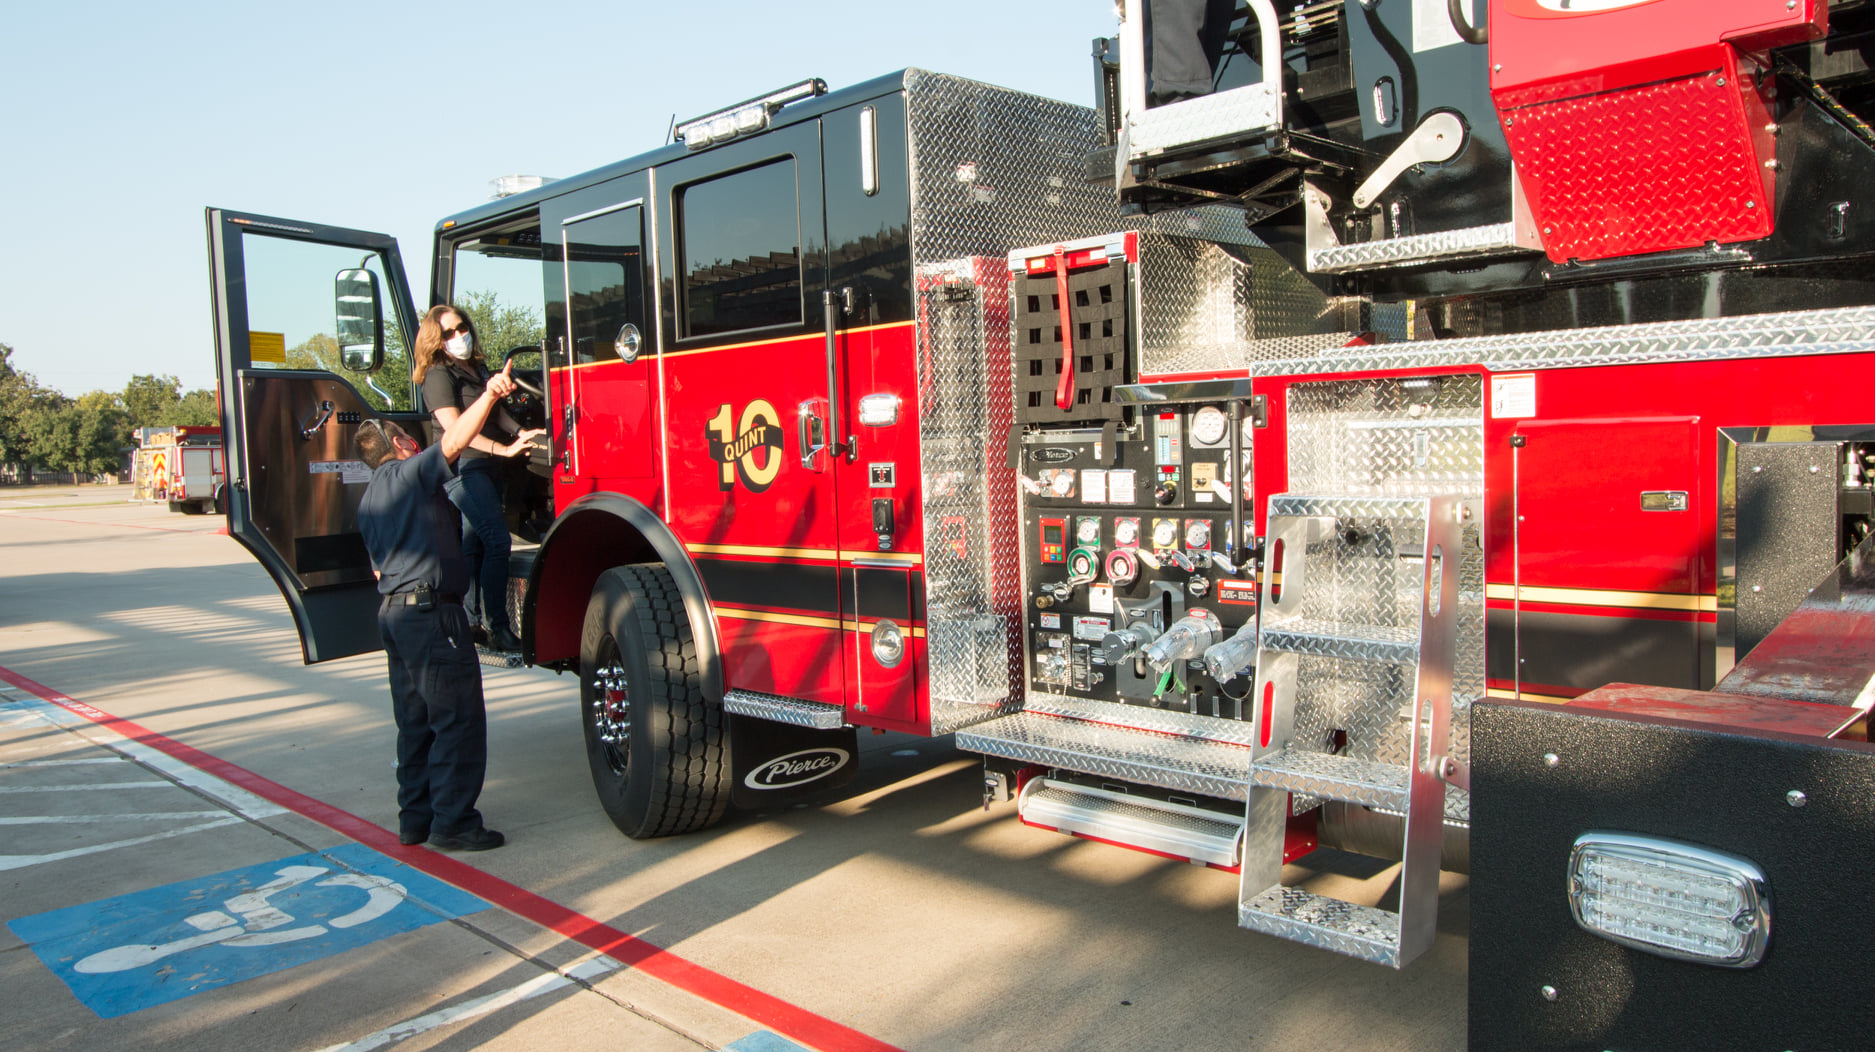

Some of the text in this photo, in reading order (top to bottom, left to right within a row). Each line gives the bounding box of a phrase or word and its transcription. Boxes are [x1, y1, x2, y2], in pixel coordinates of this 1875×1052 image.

[708, 398, 783, 486] 10
[724, 426, 767, 462] QUINT
[765, 755, 832, 783] Pierce
